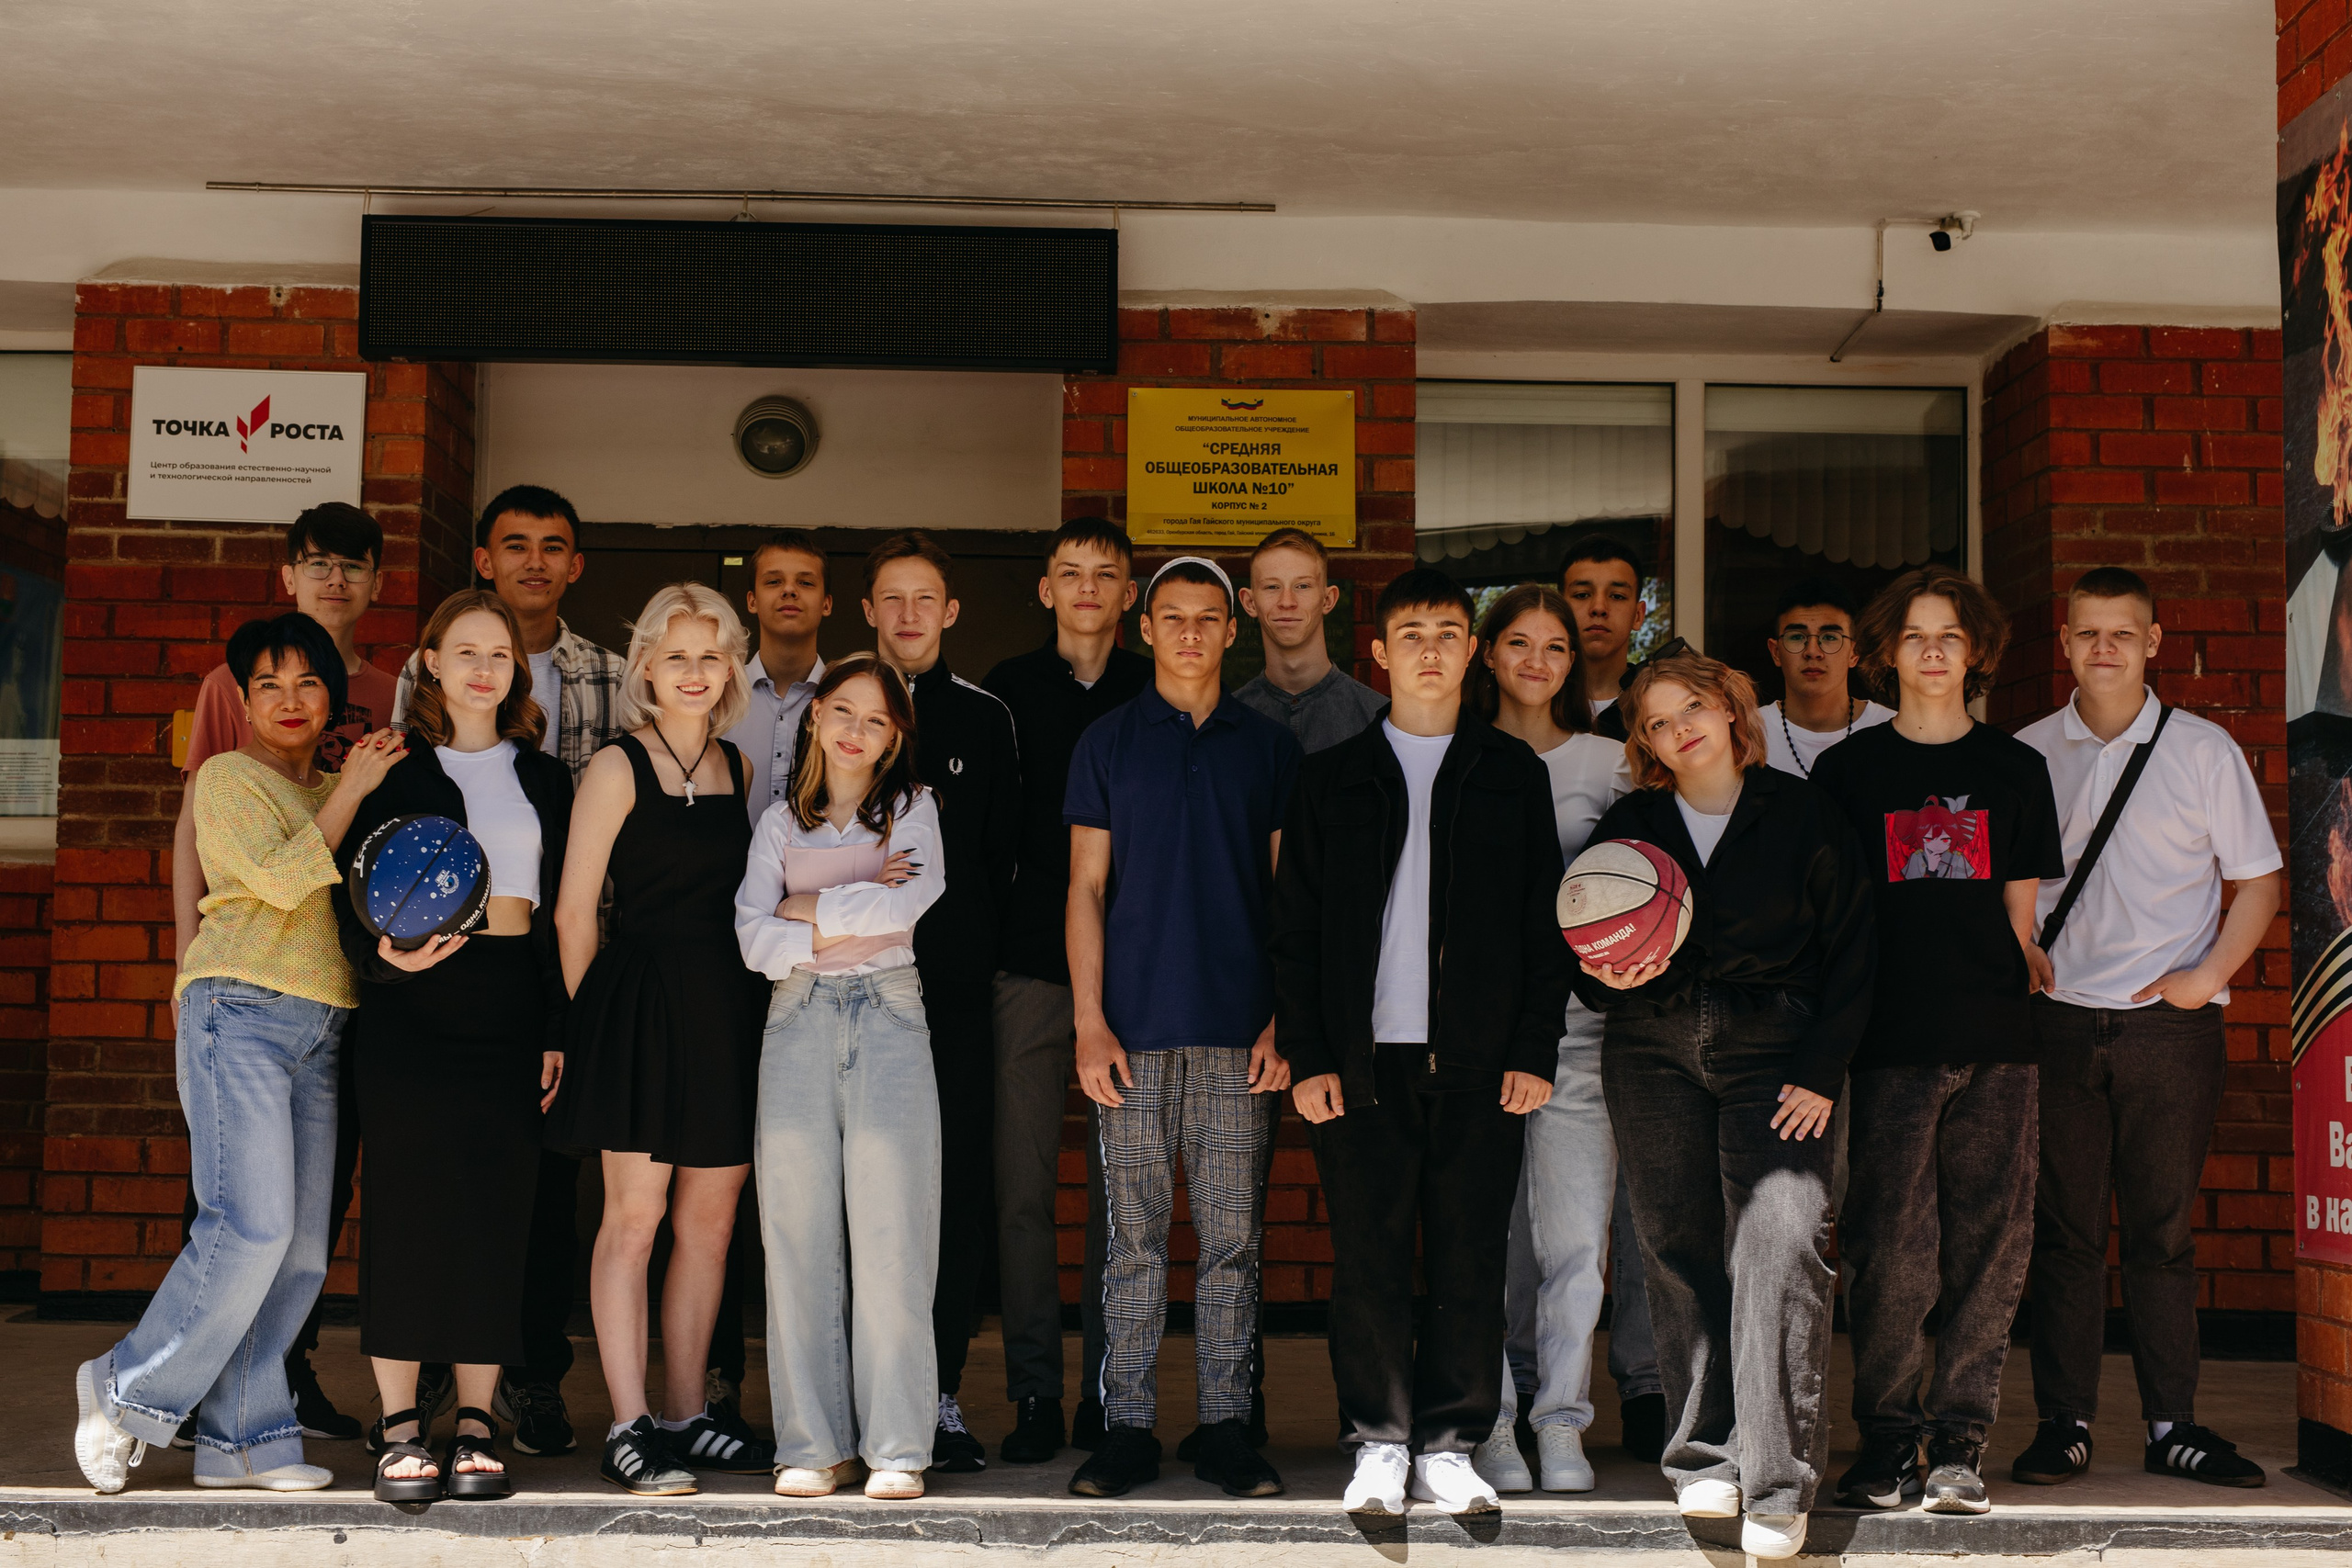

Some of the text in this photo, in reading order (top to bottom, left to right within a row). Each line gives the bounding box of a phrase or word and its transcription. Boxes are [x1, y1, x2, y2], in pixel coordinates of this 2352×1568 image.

[152, 419, 345, 441] ТОЧКА РОСТА
[1175, 425, 1263, 434] ОБЩЕОБРАЗОВАТЕЛЬНОЕ
[150, 461, 332, 474] Центр образования естественно-научной
[1145, 461, 1339, 477] ОБЩЕОБРАЗОВАТЕЛЬНАЯ
[158, 472, 232, 481] технологической
[234, 475, 311, 484] направленностей
[1193, 482, 1248, 495] ШКОЛА
[1211, 502, 1247, 510] КОРПУС
[1249, 502, 1260, 511] №
[1163, 518, 1188, 526] города
[1203, 517, 1235, 526] Гайского
[1236, 519, 1295, 528] муниципального
[1296, 520, 1321, 528] округа
[459, 908, 481, 931] ОДНА
[1591, 922, 1636, 951] КОМАНДА!
